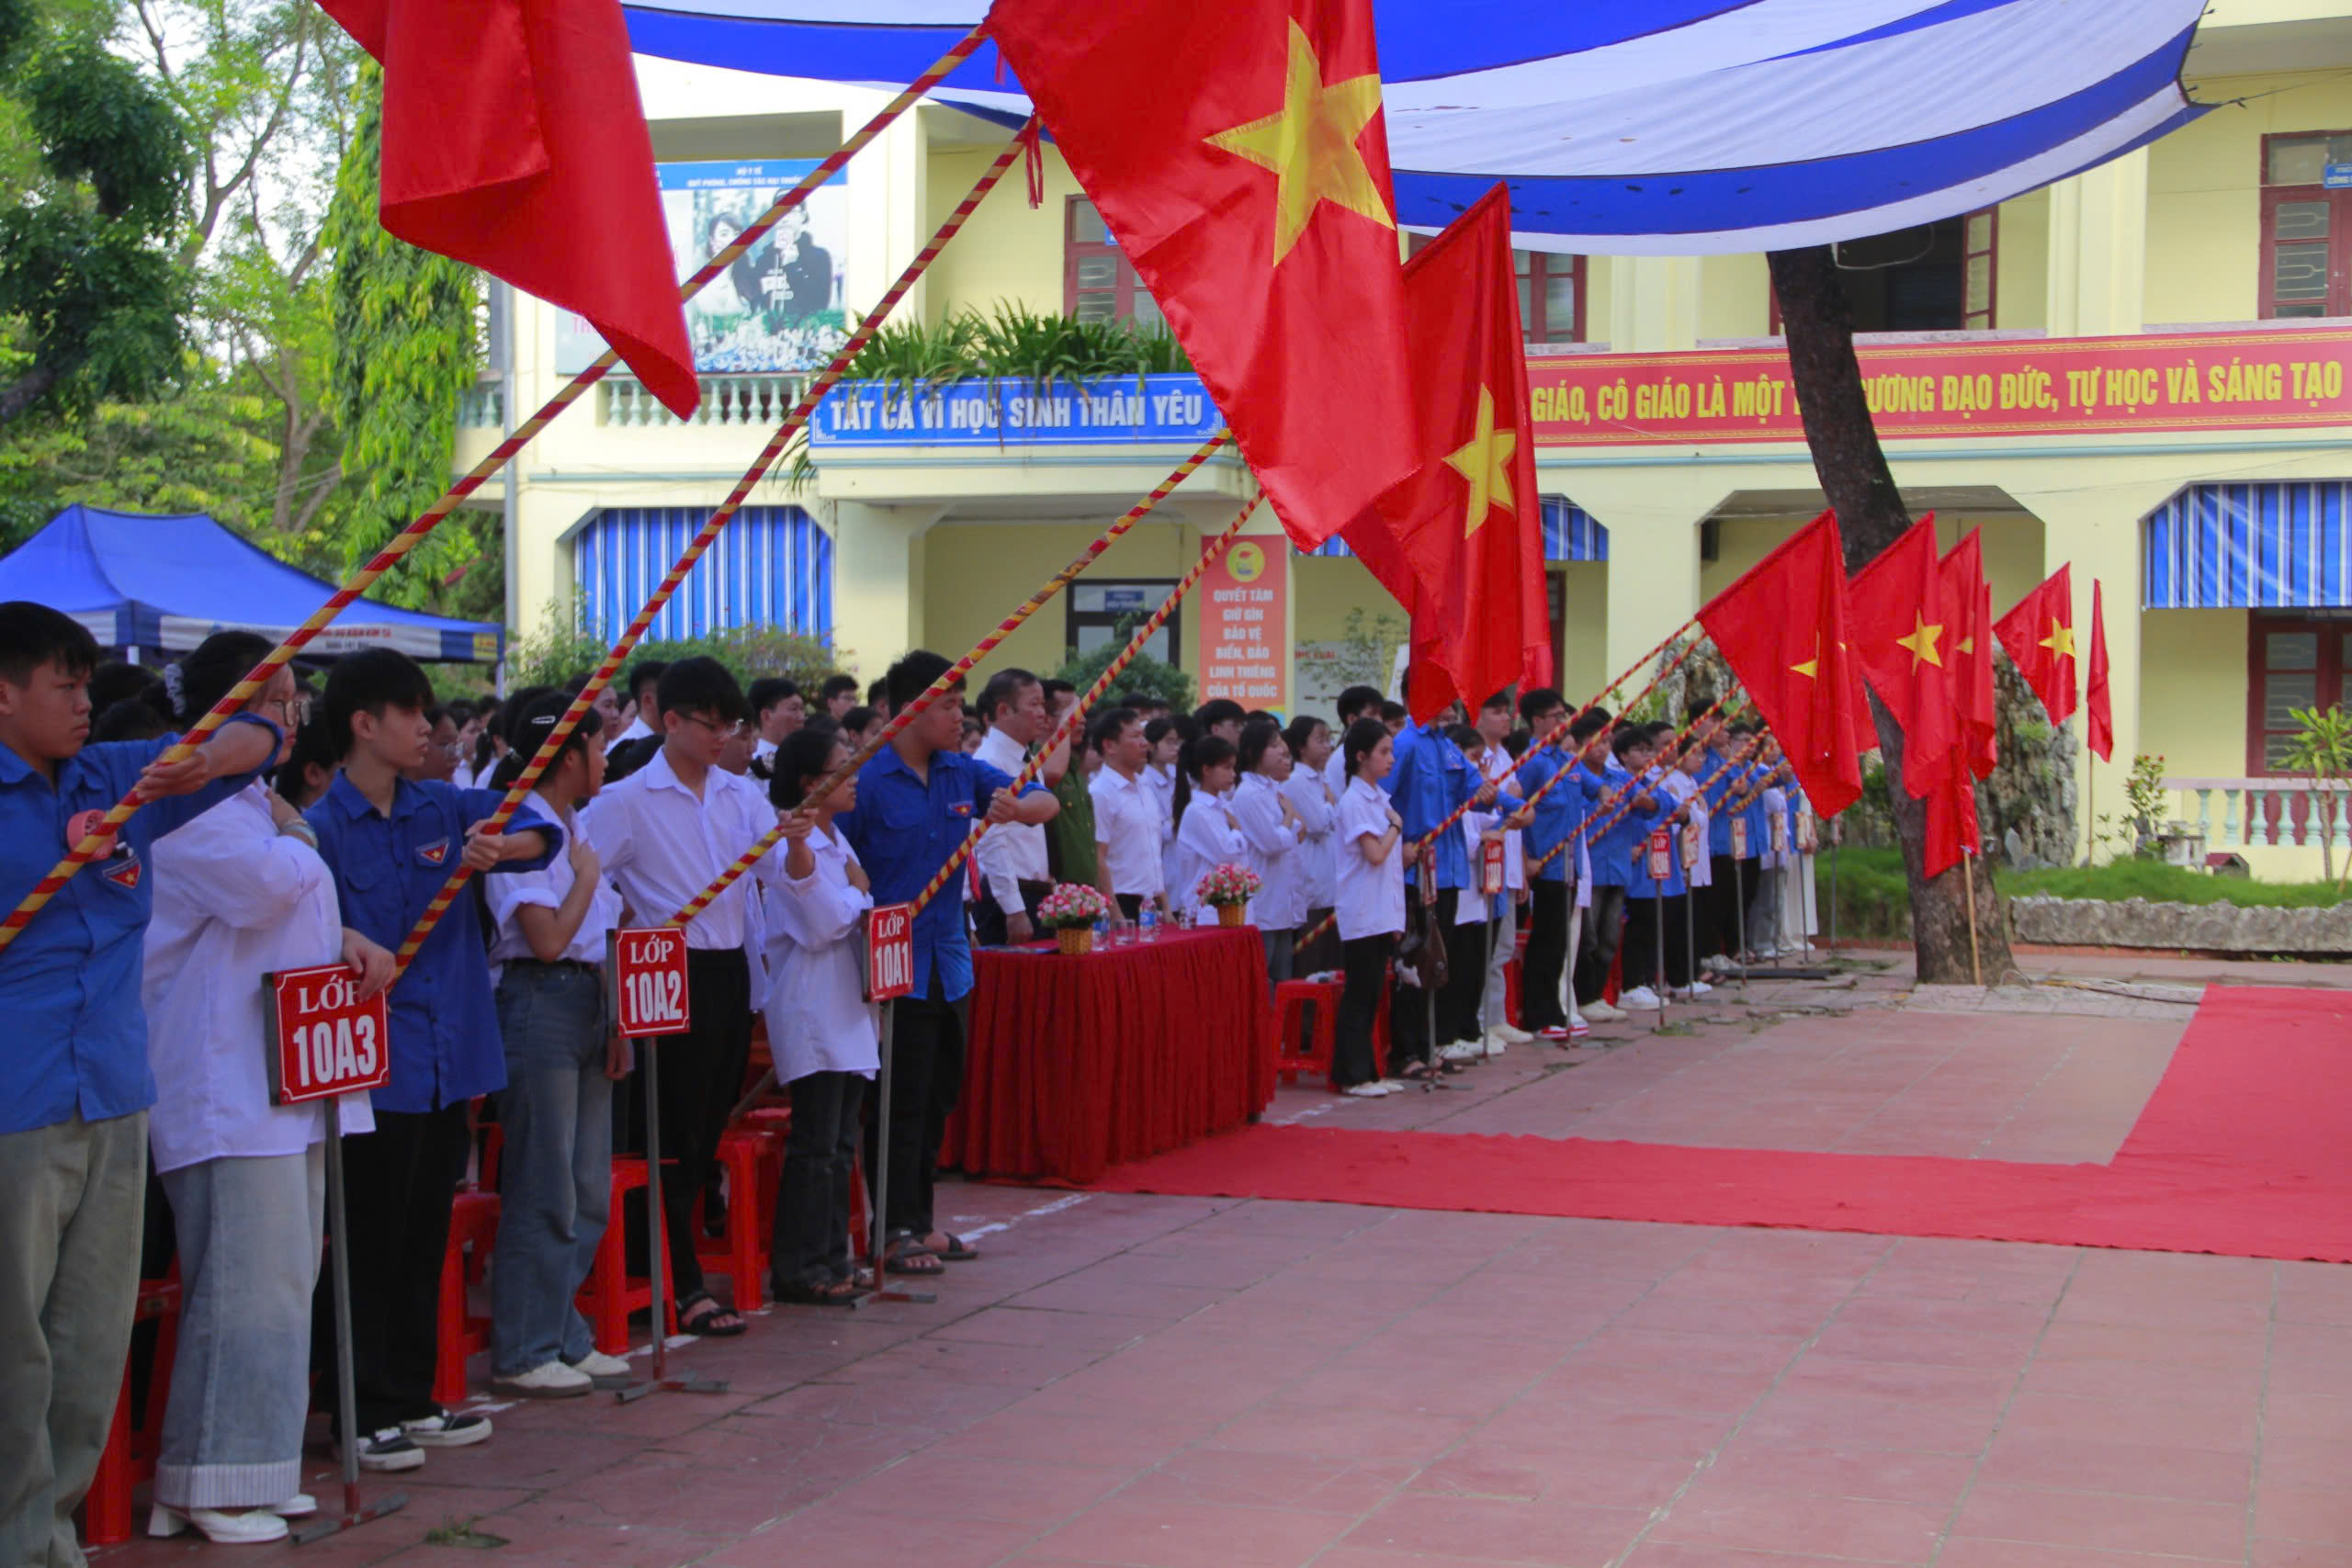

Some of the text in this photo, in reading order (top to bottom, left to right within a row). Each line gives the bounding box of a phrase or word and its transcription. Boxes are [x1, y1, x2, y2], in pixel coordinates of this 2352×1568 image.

[882, 390, 915, 431] CẢ
[922, 392, 944, 430] VÌ
[951, 399, 1001, 435] HỌC
[1009, 396, 1071, 428] SINH
[1079, 390, 1147, 427] THÂN
[1152, 389, 1204, 426] YÊU
[1532, 378, 1590, 425] GIÁO,
[1598, 377, 1629, 421] CÔ
[1635, 376, 1690, 420] GIÁO
[1697, 374, 1726, 418] LÀ
[1733, 373, 1786, 424] MỘT
[1861, 373, 1935, 413] ƯƠNG
[1941, 374, 1994, 419] ĐẠO
[1999, 365, 2060, 413] ĐỨC,
[2066, 367, 2102, 415] TỰ
[2106, 367, 2159, 414] HỌC
[2165, 358, 2201, 404] VÀ
[2208, 356, 2283, 402] SÁNG
[2289, 360, 2343, 408] TẠO
[878, 910, 905, 938] LỚP
[630, 933, 674, 964] LỚP
[876, 941, 909, 989] 10A1
[626, 970, 684, 1024] 10A2
[293, 1015, 378, 1088] 10A3
